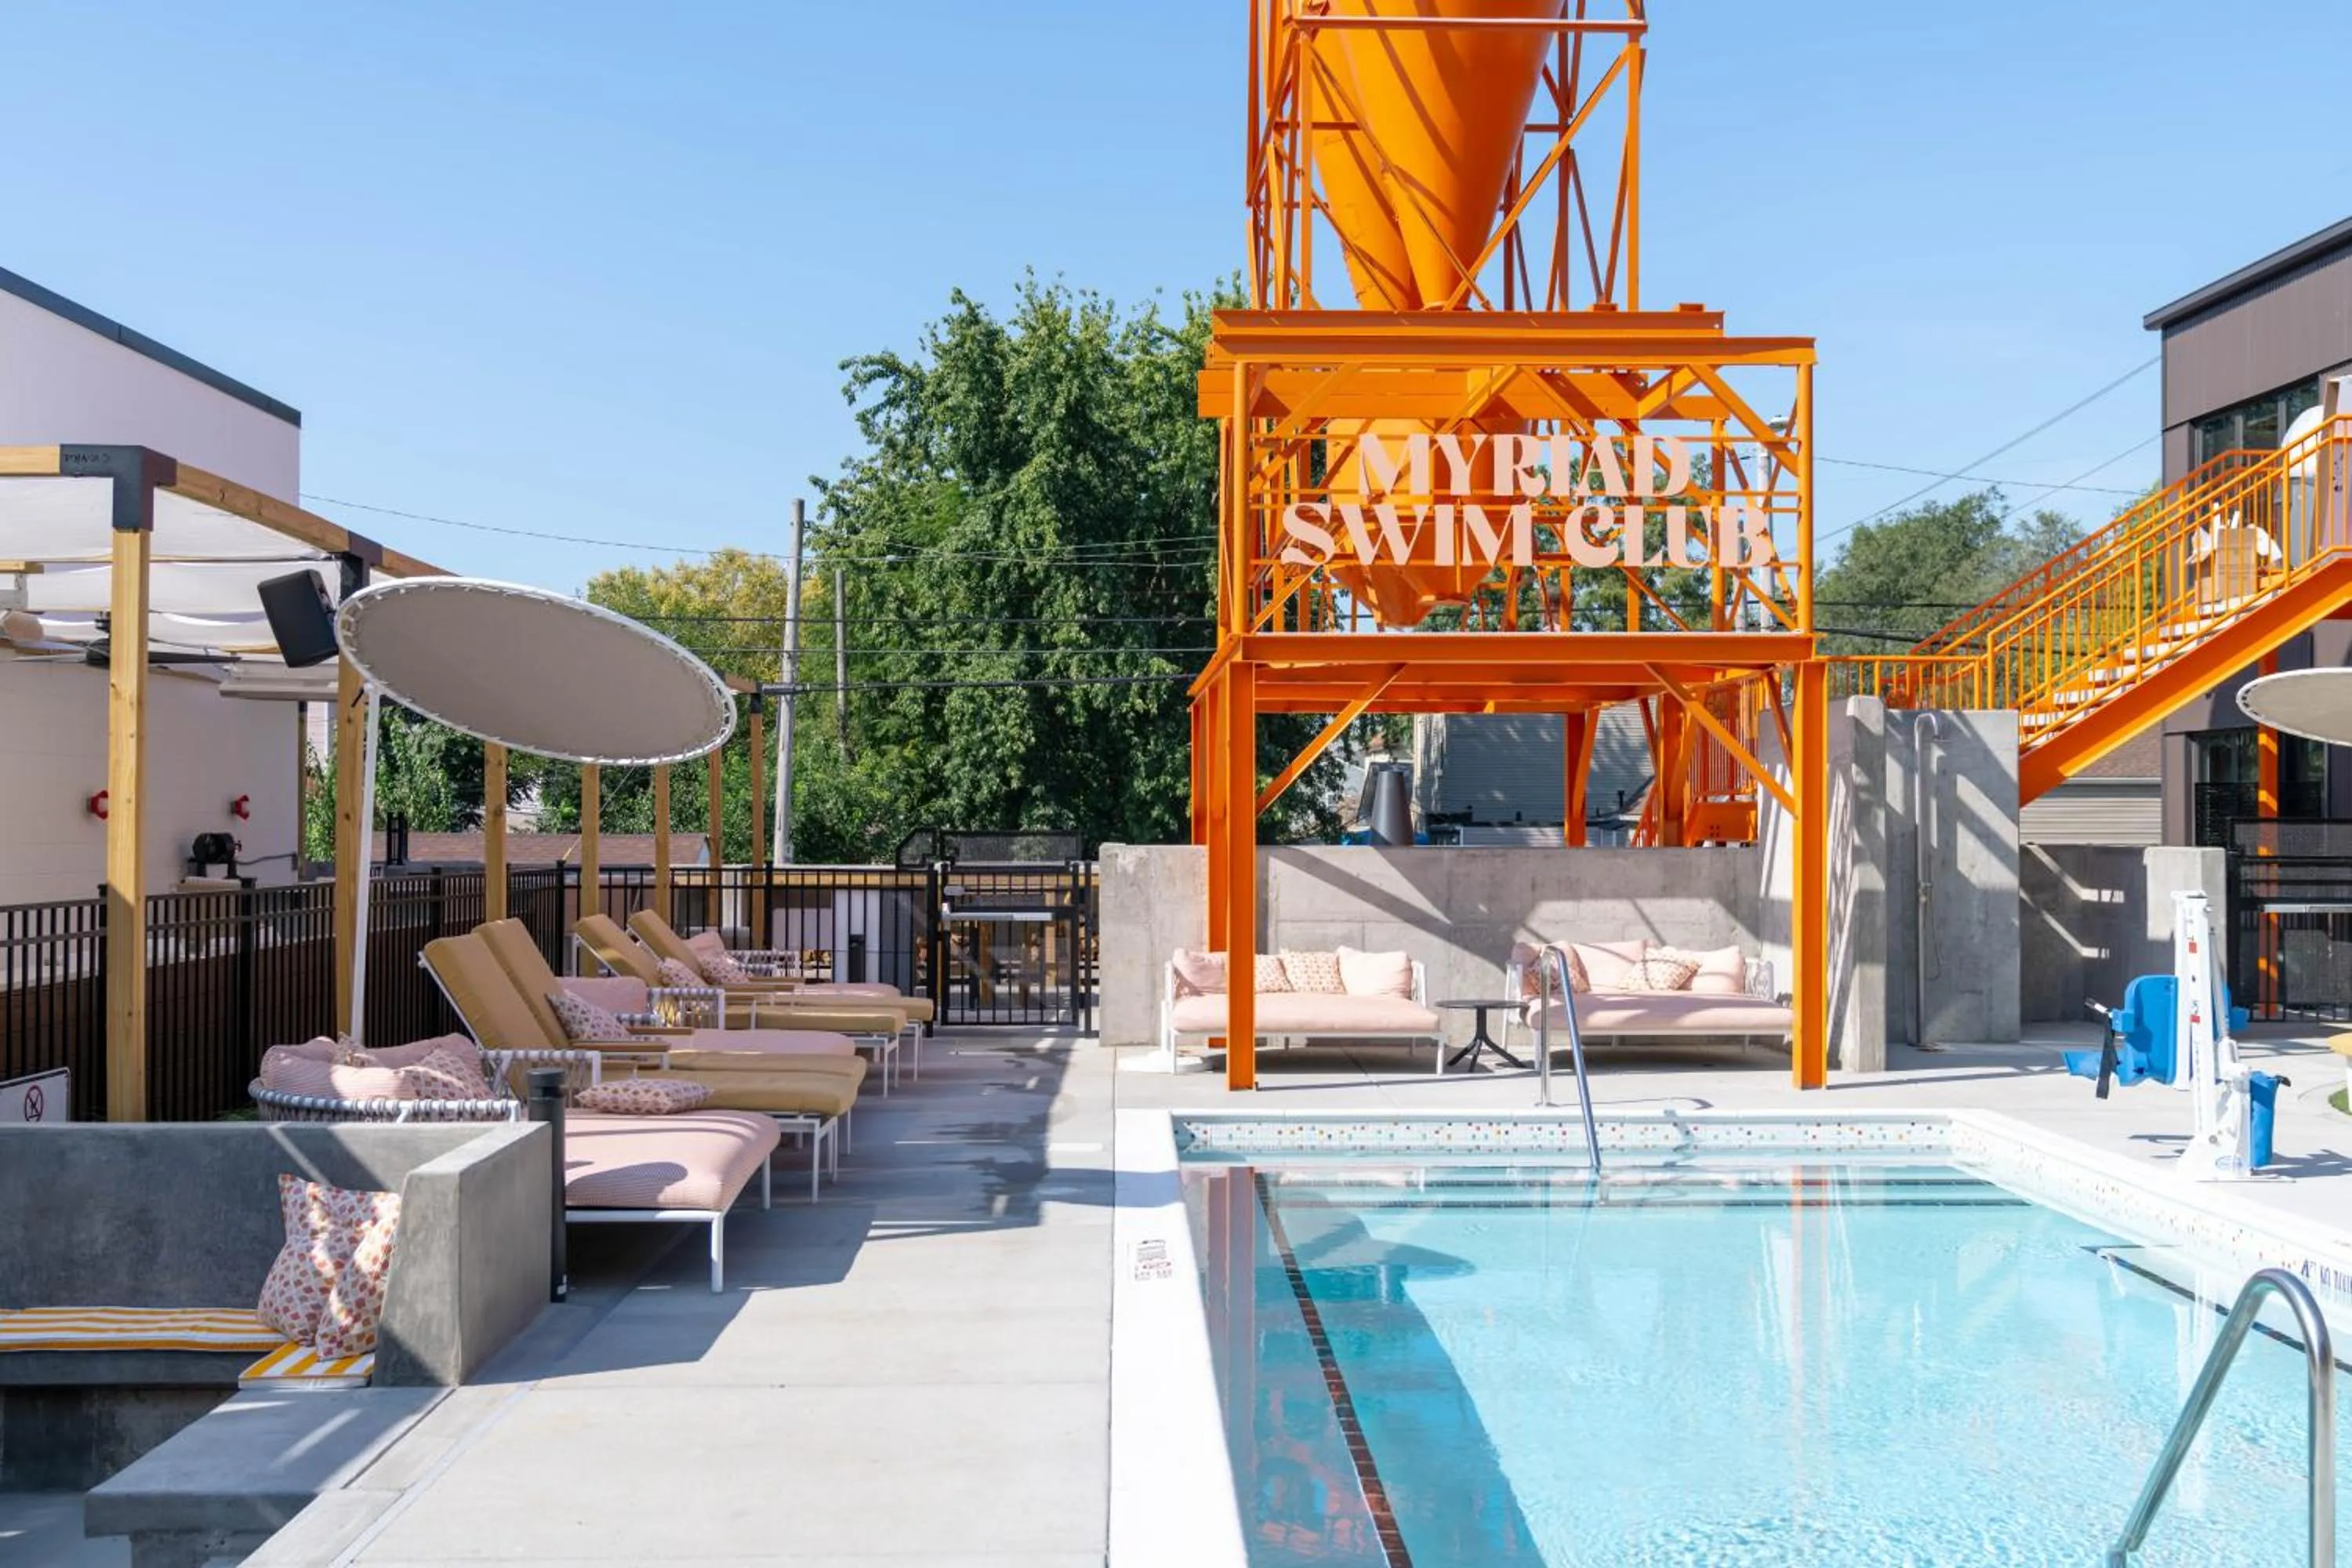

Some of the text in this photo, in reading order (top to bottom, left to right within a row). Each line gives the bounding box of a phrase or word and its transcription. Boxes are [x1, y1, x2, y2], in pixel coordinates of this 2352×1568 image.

[1359, 434, 1691, 496] MYRIAD
[1280, 503, 1774, 567] SWIM CLUB
